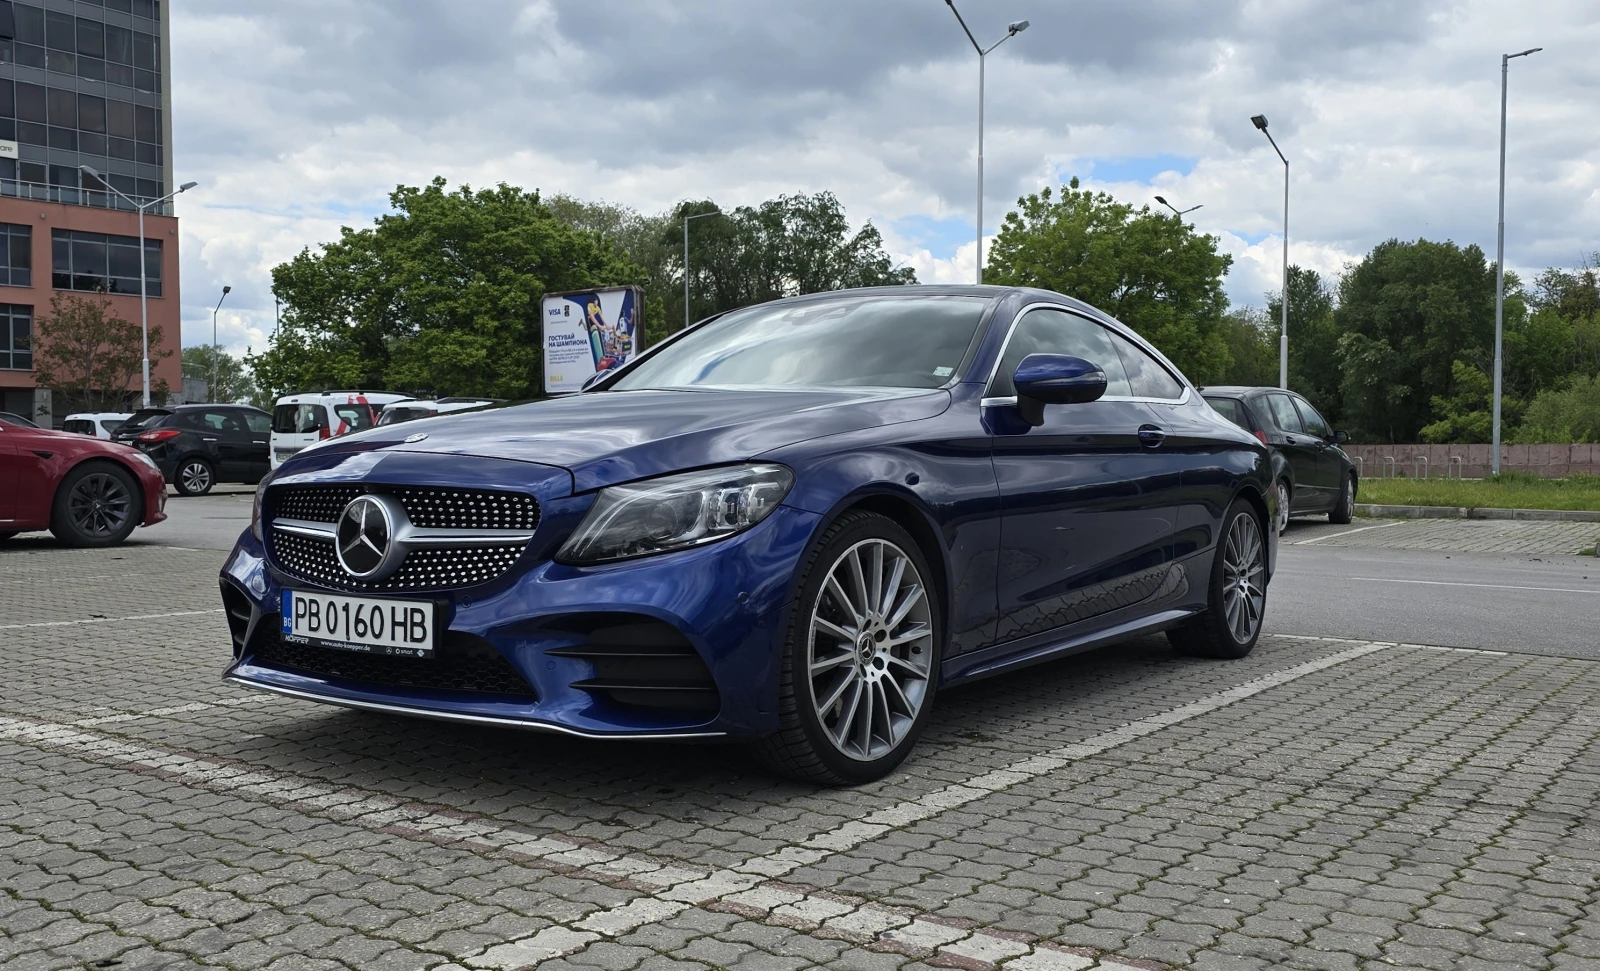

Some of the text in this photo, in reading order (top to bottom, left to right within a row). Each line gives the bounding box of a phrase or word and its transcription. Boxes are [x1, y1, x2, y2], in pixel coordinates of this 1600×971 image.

[549, 333, 575, 341] ГОСТУВАЙ
[283, 616, 292, 628] BG
[295, 597, 427, 643] PB 0160 HB
